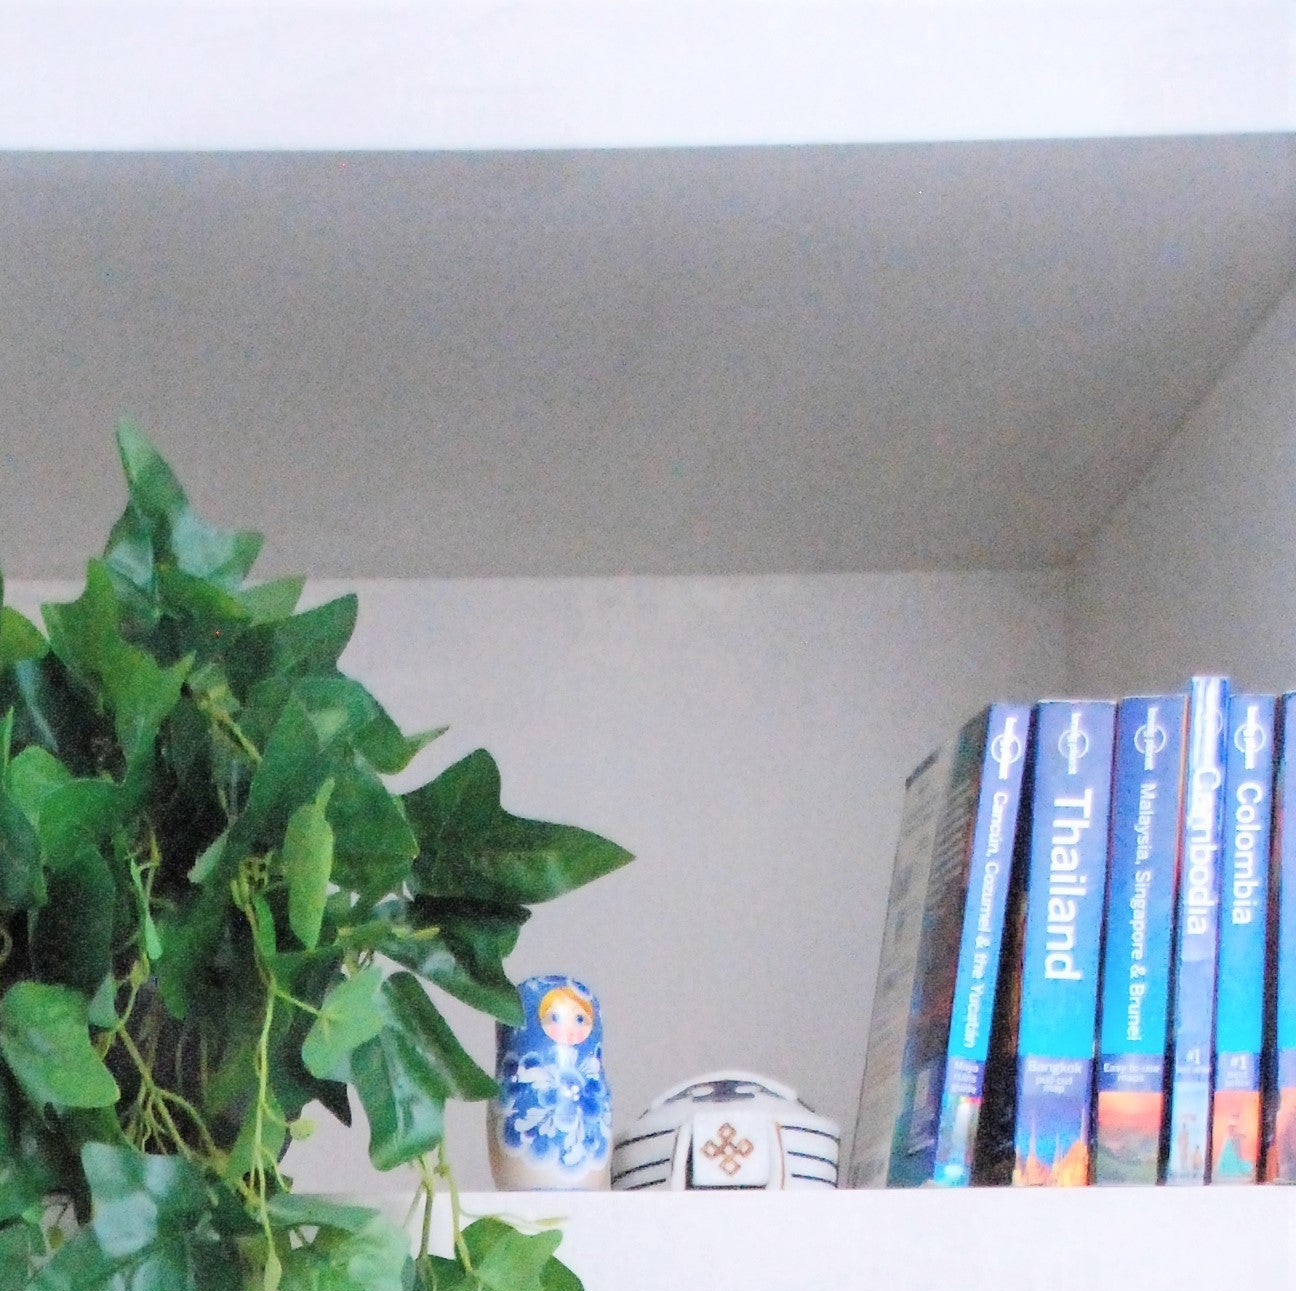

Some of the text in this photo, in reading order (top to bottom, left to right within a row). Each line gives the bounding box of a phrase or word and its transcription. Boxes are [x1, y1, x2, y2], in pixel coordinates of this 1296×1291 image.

[1134, 783, 1157, 864] Malaysia,
[1187, 768, 1221, 935] Cmbodia
[1232, 782, 1262, 924] Colombia
[977, 861, 999, 932] Cozumel
[1045, 788, 1093, 980] Thailand
[1129, 870, 1151, 960] Singapore
[972, 952, 988, 979] the
[976, 935, 991, 949] &
[1130, 964, 1146, 979] &
[1126, 983, 1146, 1040] Brunei
[1027, 1060, 1082, 1075] Bangkok
[1230, 1055, 1248, 1070] #1
